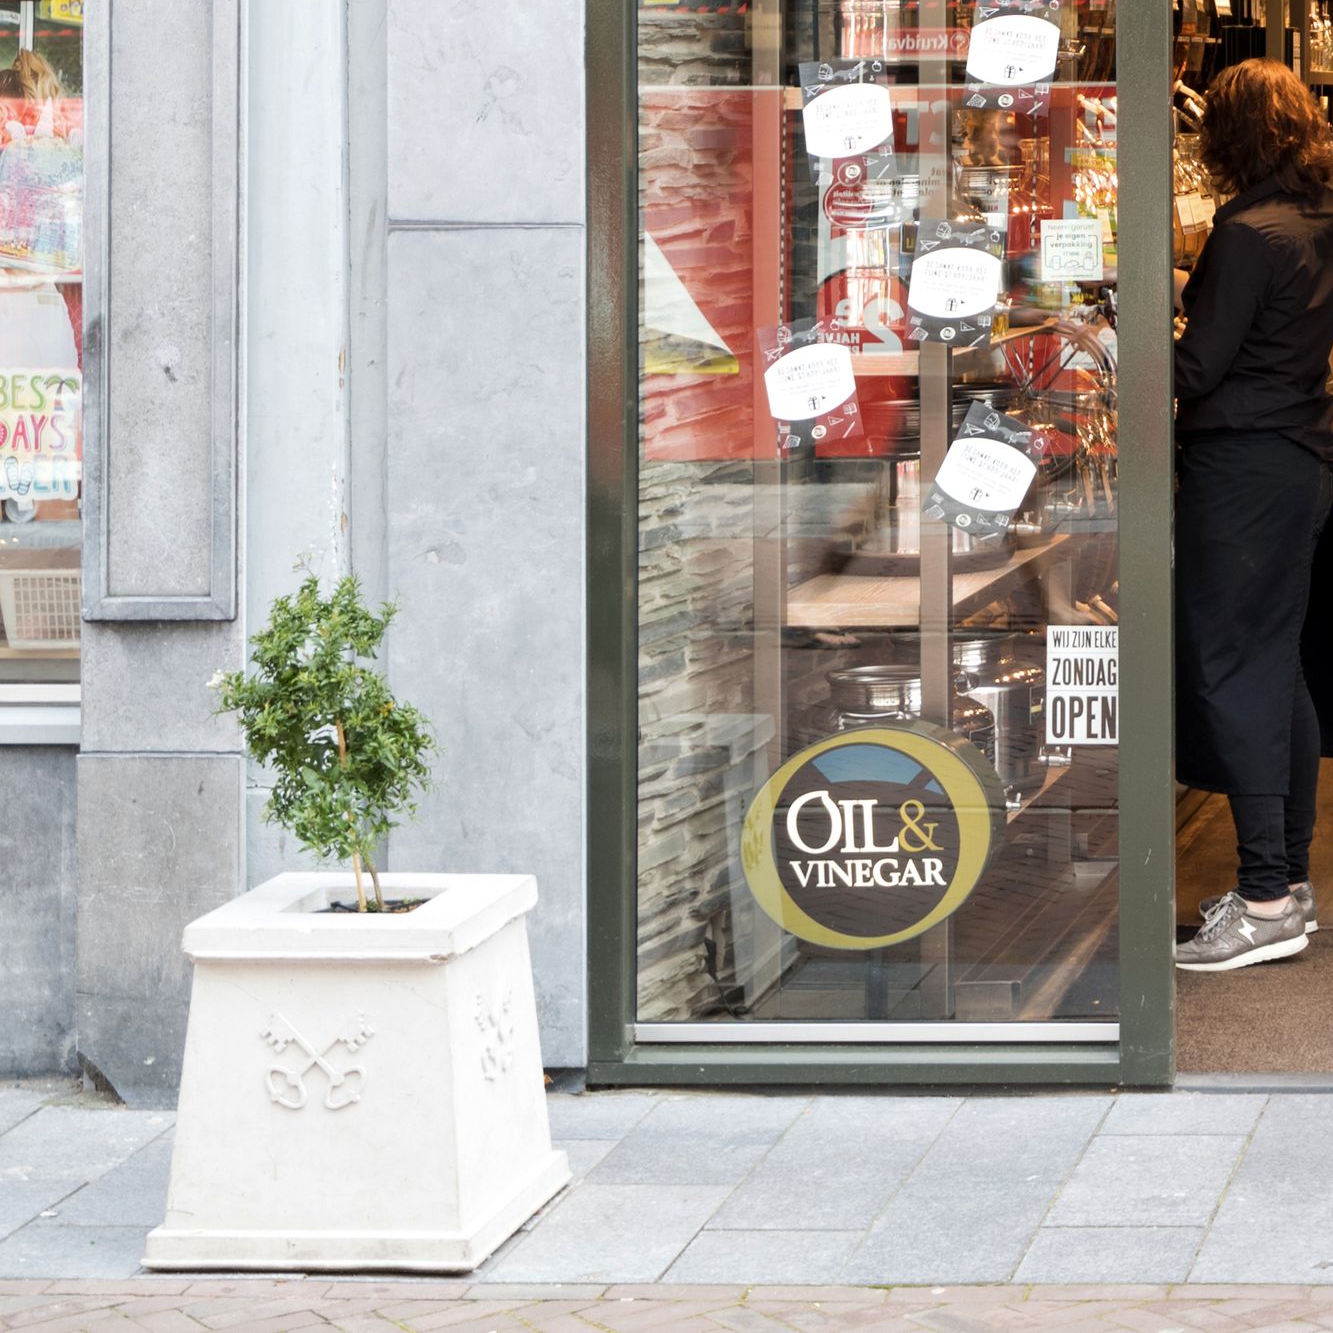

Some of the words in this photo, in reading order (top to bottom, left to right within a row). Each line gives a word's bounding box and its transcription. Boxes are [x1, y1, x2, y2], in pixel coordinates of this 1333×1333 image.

[1052, 630, 1070, 648] WIJ
[1072, 630, 1092, 648] ZIJN
[1094, 630, 1117, 648] ELKE
[1052, 658, 1117, 686] ZONDAG
[1052, 695, 1117, 739] OPEN
[786, 790, 944, 854] OIL&
[790, 857, 947, 888] VINEGAR
